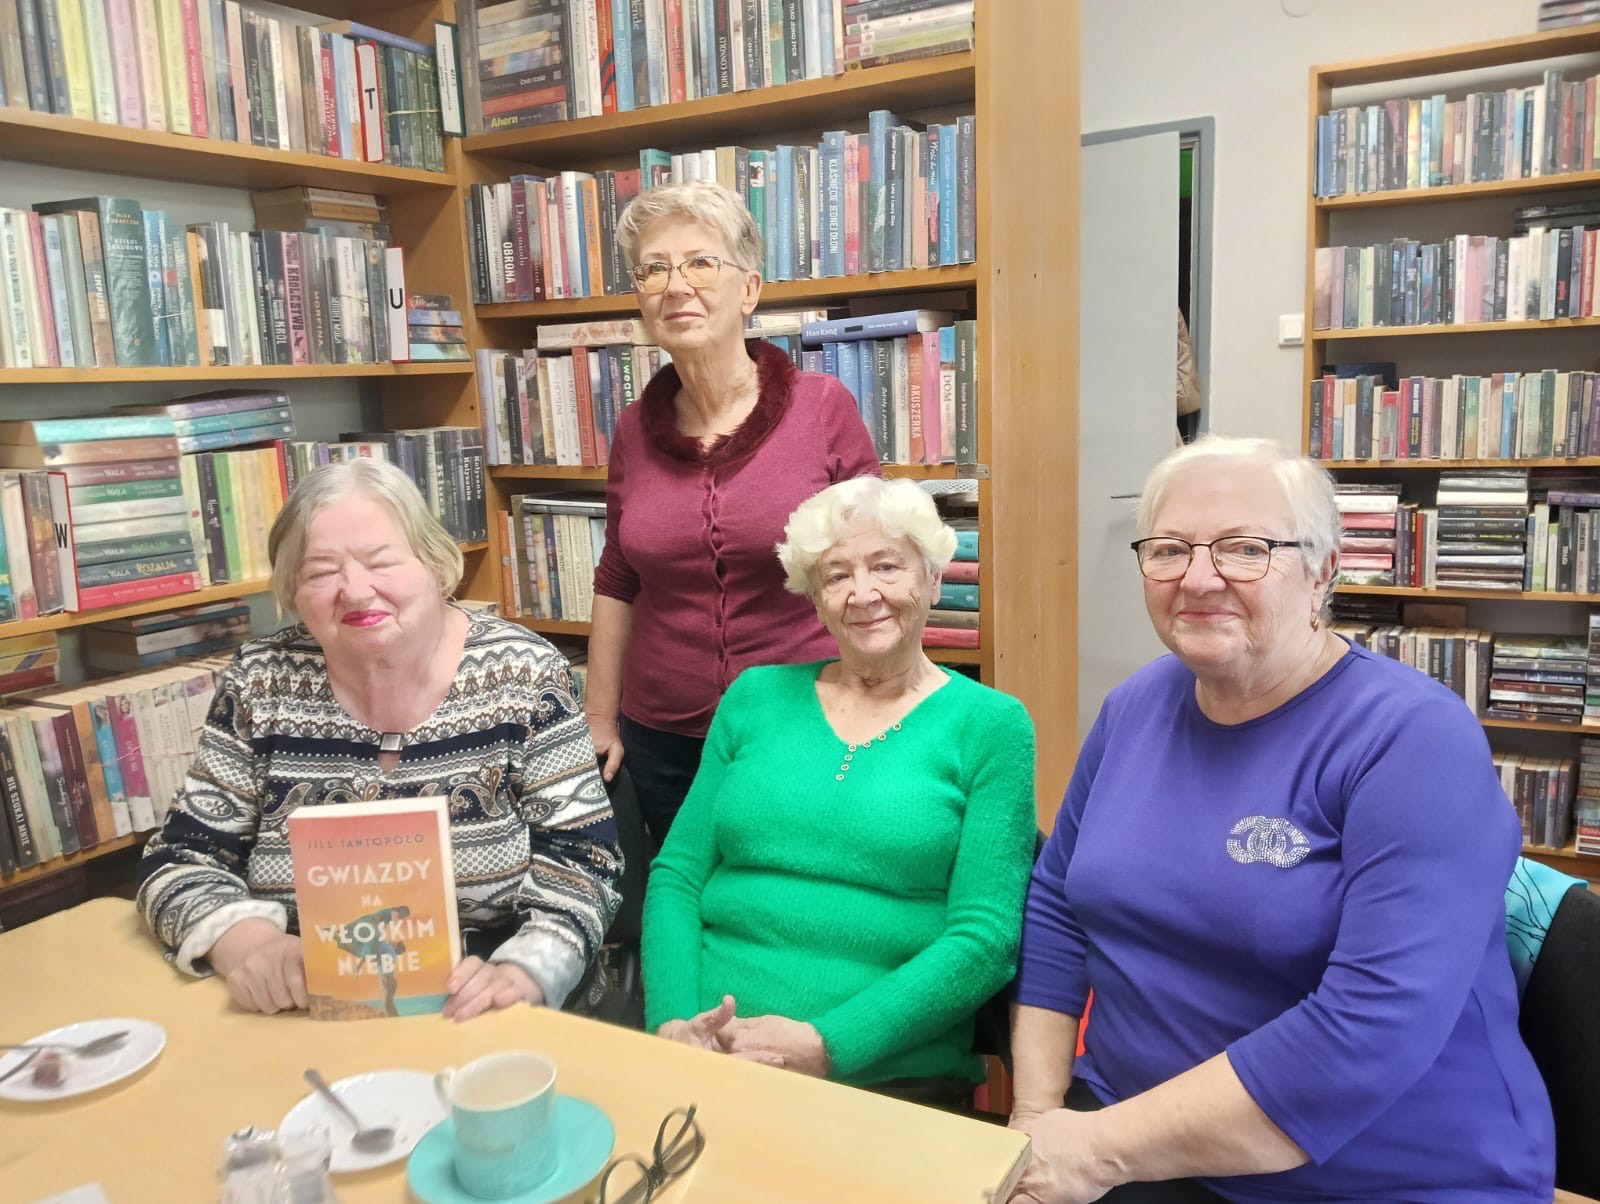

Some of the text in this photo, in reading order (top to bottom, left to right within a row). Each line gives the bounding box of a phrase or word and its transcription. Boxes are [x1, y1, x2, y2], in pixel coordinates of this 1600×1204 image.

[364, 87, 376, 110] T
[490, 115, 519, 129] Ahern
[827, 158, 841, 203] KLAŚNIĘCIE
[828, 205, 839, 231] JEDNEJ
[503, 241, 516, 284] OBRONA
[389, 287, 404, 309] U
[313, 290, 324, 347] MORFINA
[806, 327, 838, 337] Han Kang
[943, 375, 952, 402] DOM
[910, 385, 921, 439] AKUSZERKA
[54, 522, 68, 549] W
[135, 560, 177, 576] ROZALIA
[6, 776, 30, 847] NIE SZUKAJ MNIE
[307, 834, 425, 849] JILL SANTOPOLO
[307, 859, 432, 887] GWIAZDY
[360, 895, 382, 906] NA
[314, 918, 435, 944] WŁOSKIM
[337, 951, 421, 976] NIEBIE
